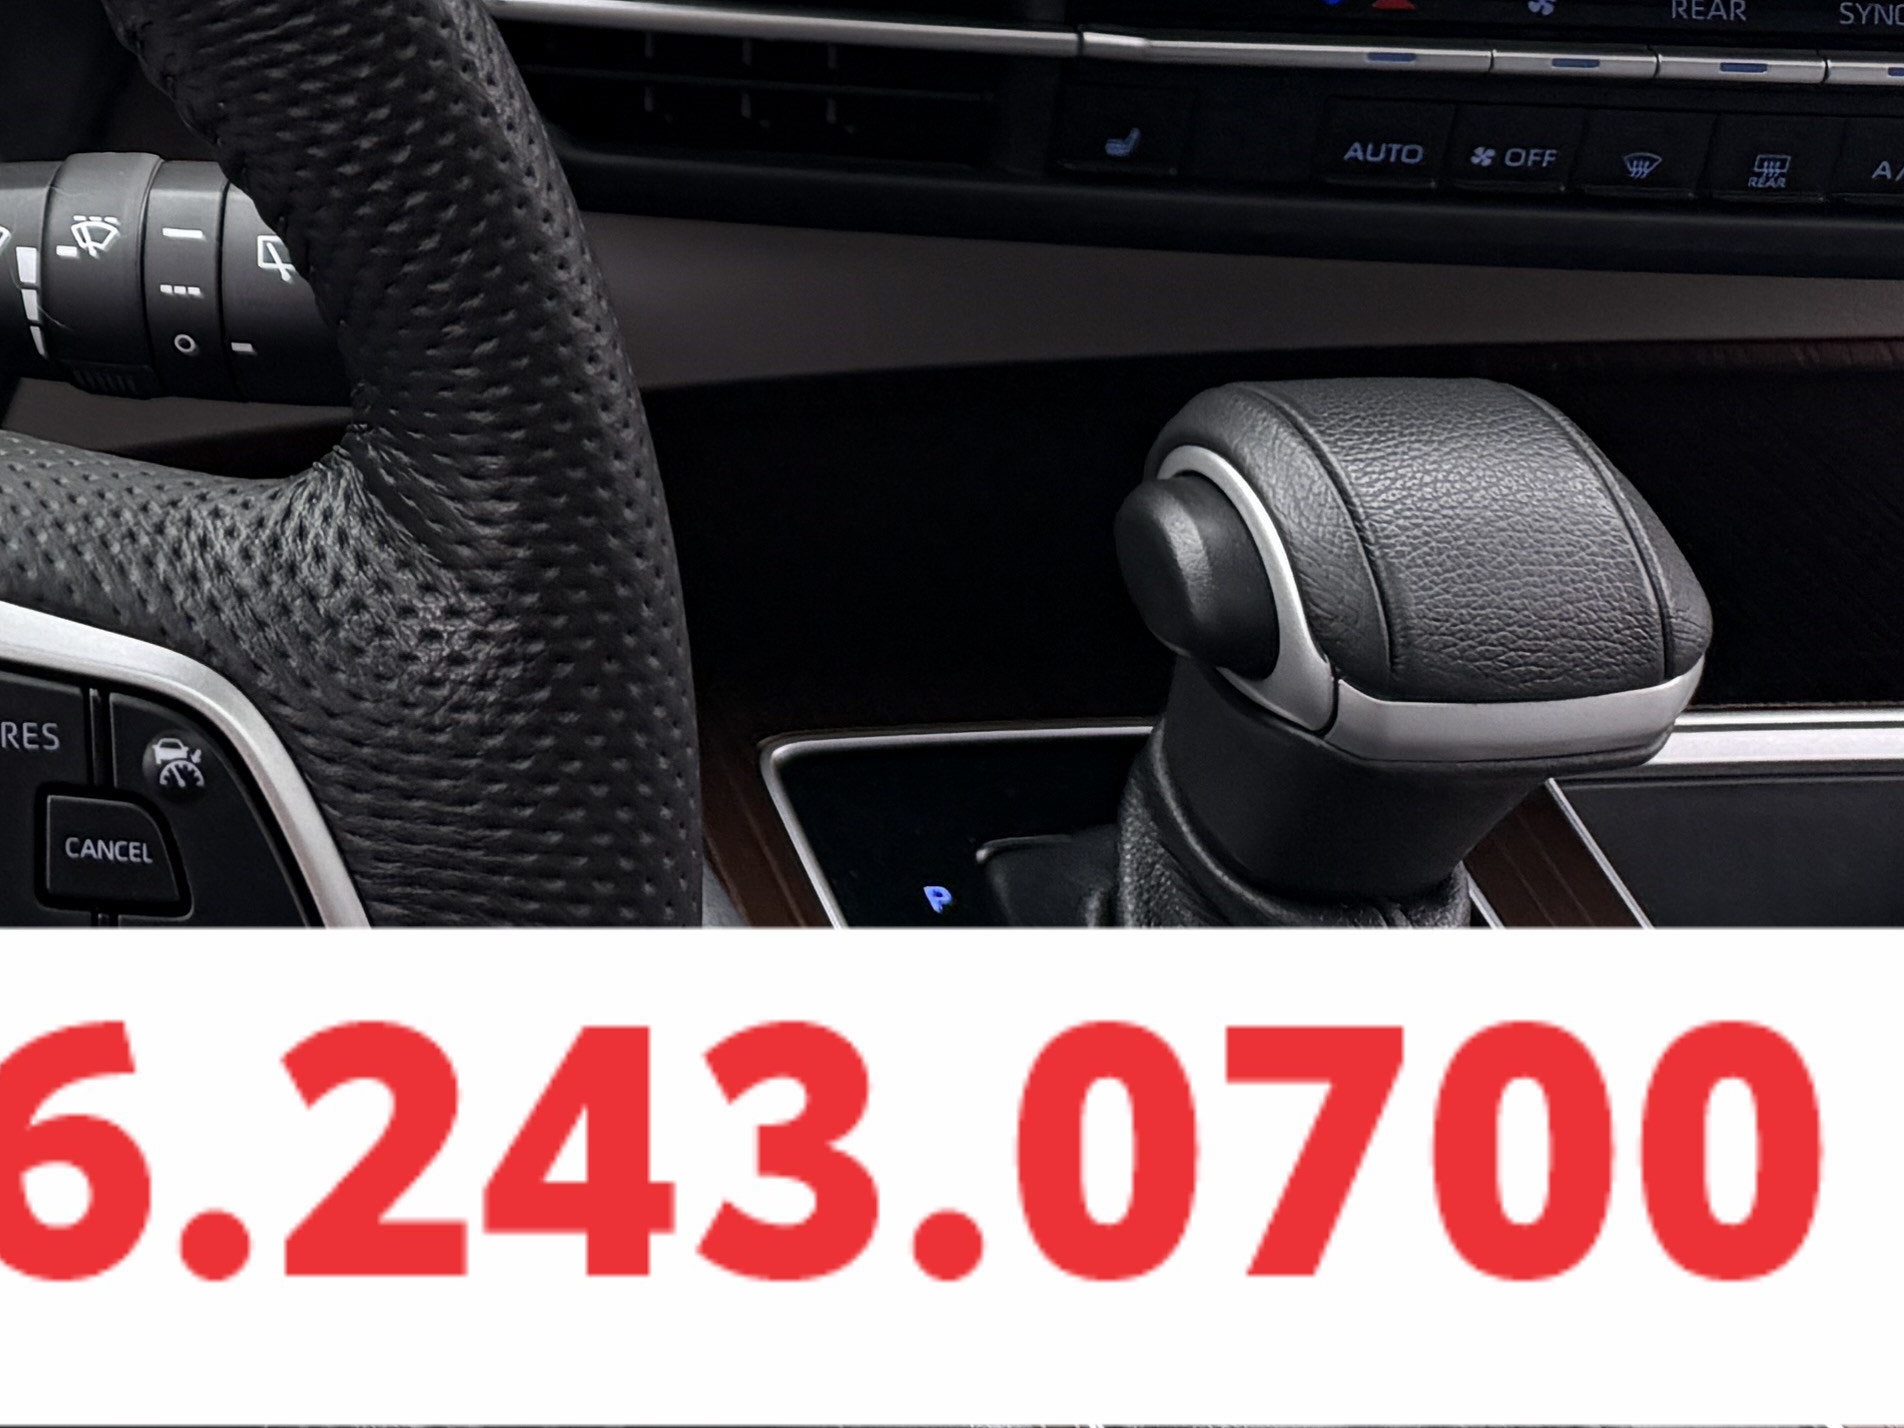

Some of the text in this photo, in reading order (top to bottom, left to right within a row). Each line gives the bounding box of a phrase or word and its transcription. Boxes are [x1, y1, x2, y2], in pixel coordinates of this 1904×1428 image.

[1344, 142, 1557, 167] AUTO OFF
[1747, 174, 1788, 189] REAR
[65, 837, 152, 863] CANCEL
[923, 885, 954, 914] P
